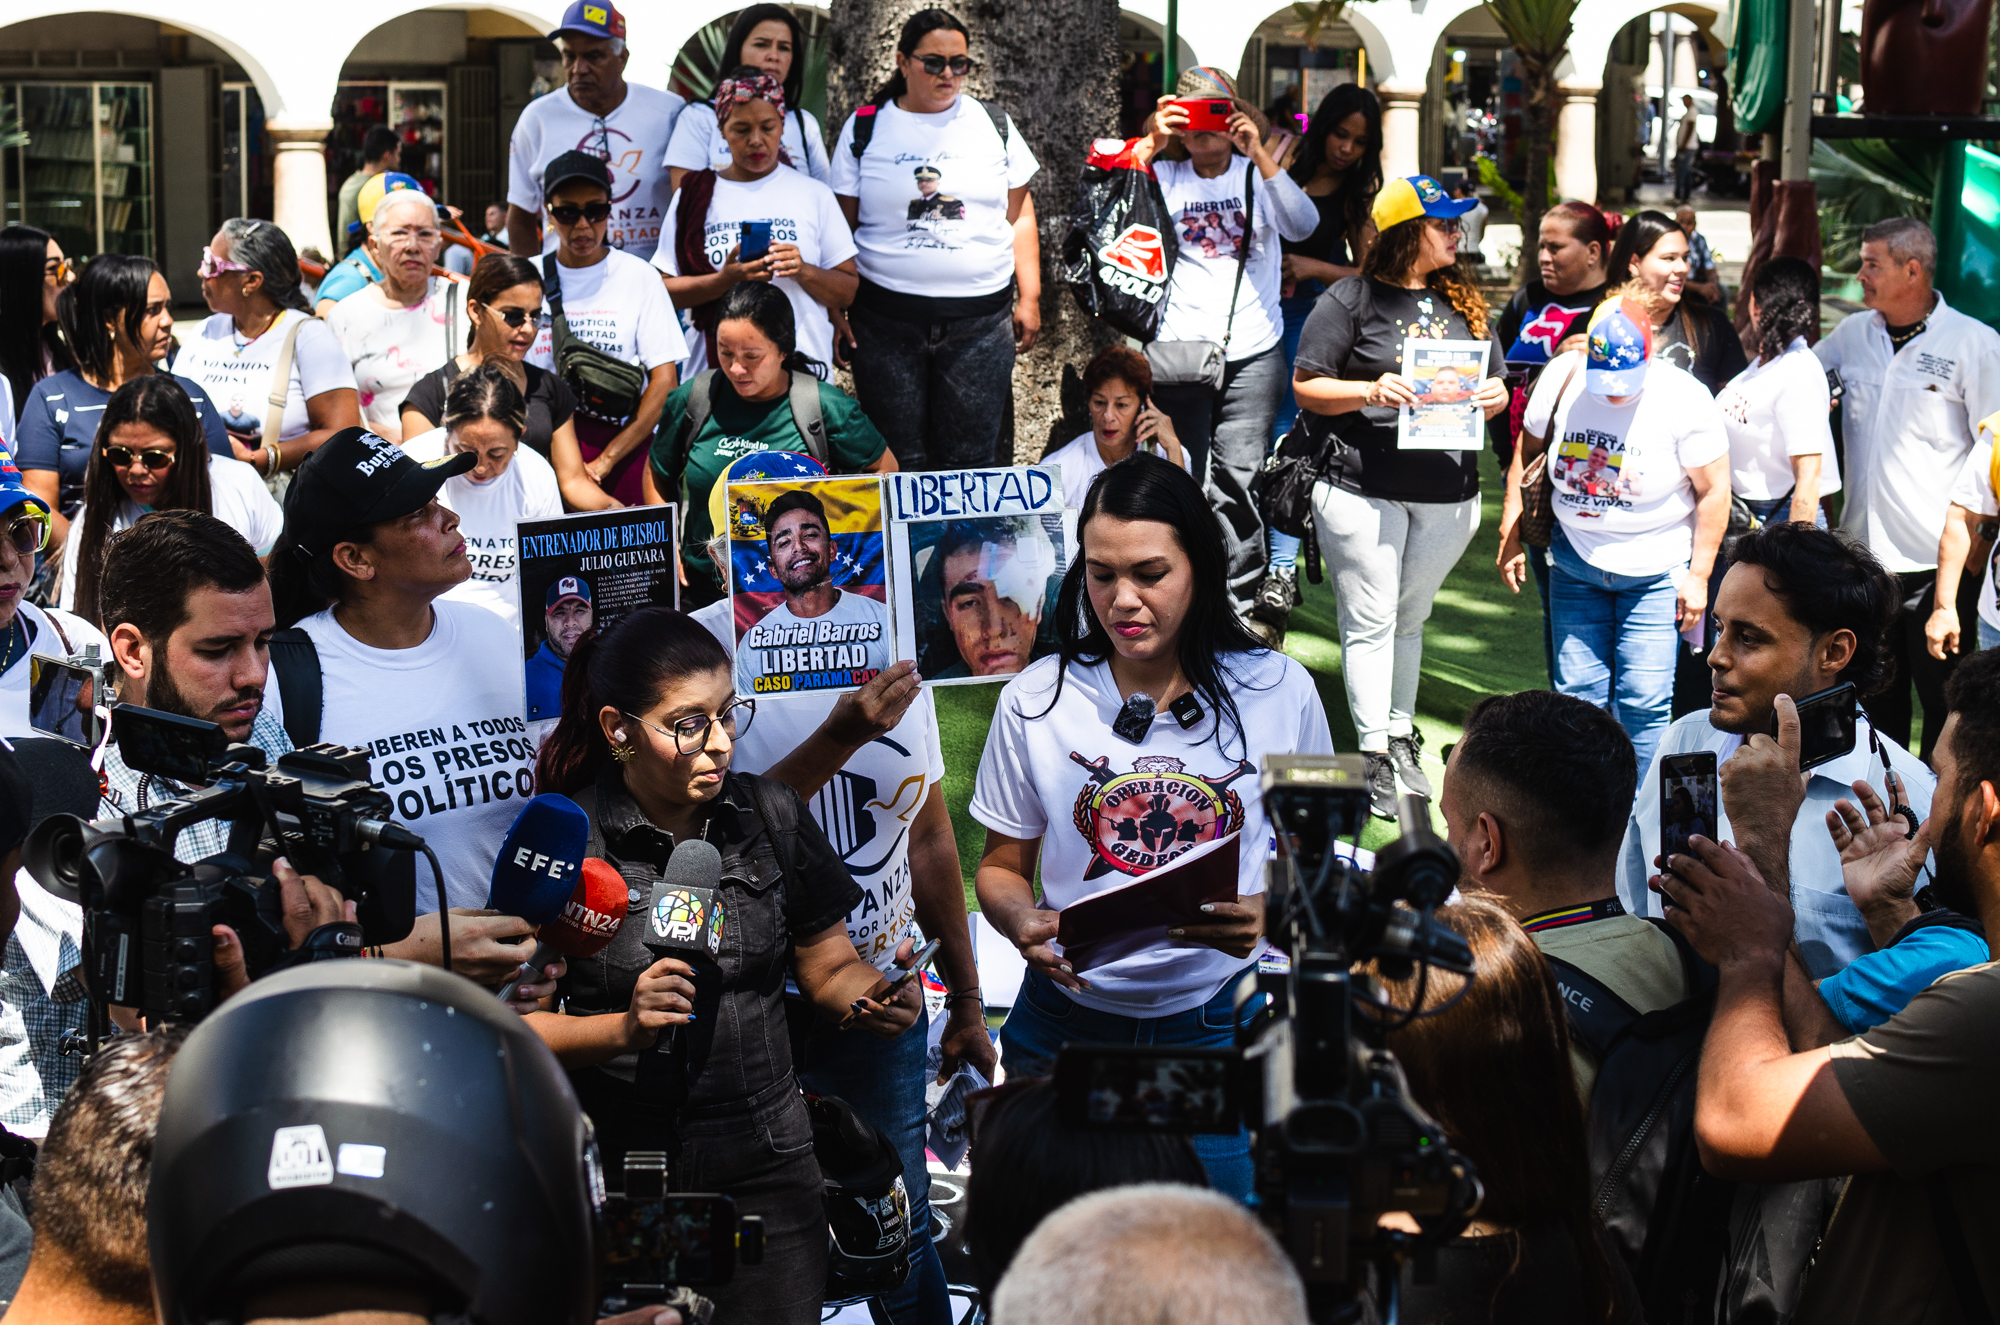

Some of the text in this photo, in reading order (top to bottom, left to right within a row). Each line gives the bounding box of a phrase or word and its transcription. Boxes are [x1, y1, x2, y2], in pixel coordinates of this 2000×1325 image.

[1183, 197, 1242, 213] LIBERTAD
[1098, 265, 1164, 304] APOLO
[741, 439, 759, 450] kind
[760, 442, 769, 450] to
[1563, 432, 1642, 457] LIBERTAD
[894, 469, 1052, 520] LIBERTAD
[486, 538, 496, 549] A
[522, 520, 669, 559] ENTRENADOR DE BEISBOL
[580, 548, 665, 572] JULIO GUEVARA
[749, 620, 880, 649] Gabriel Barros
[761, 644, 867, 675] LIBERTAD
[754, 675, 791, 692] CASO
[367, 716, 526, 761] IBEREN A TODOS
[432, 737, 538, 775] PRESOS
[397, 767, 534, 821] OLÍTICO
[1105, 780, 1214, 812] OPERACION
[564, 901, 621, 932] NTN24
[884, 907, 895, 925] LA
[678, 935, 691, 943] TV
[1557, 981, 1594, 1013] NCE
